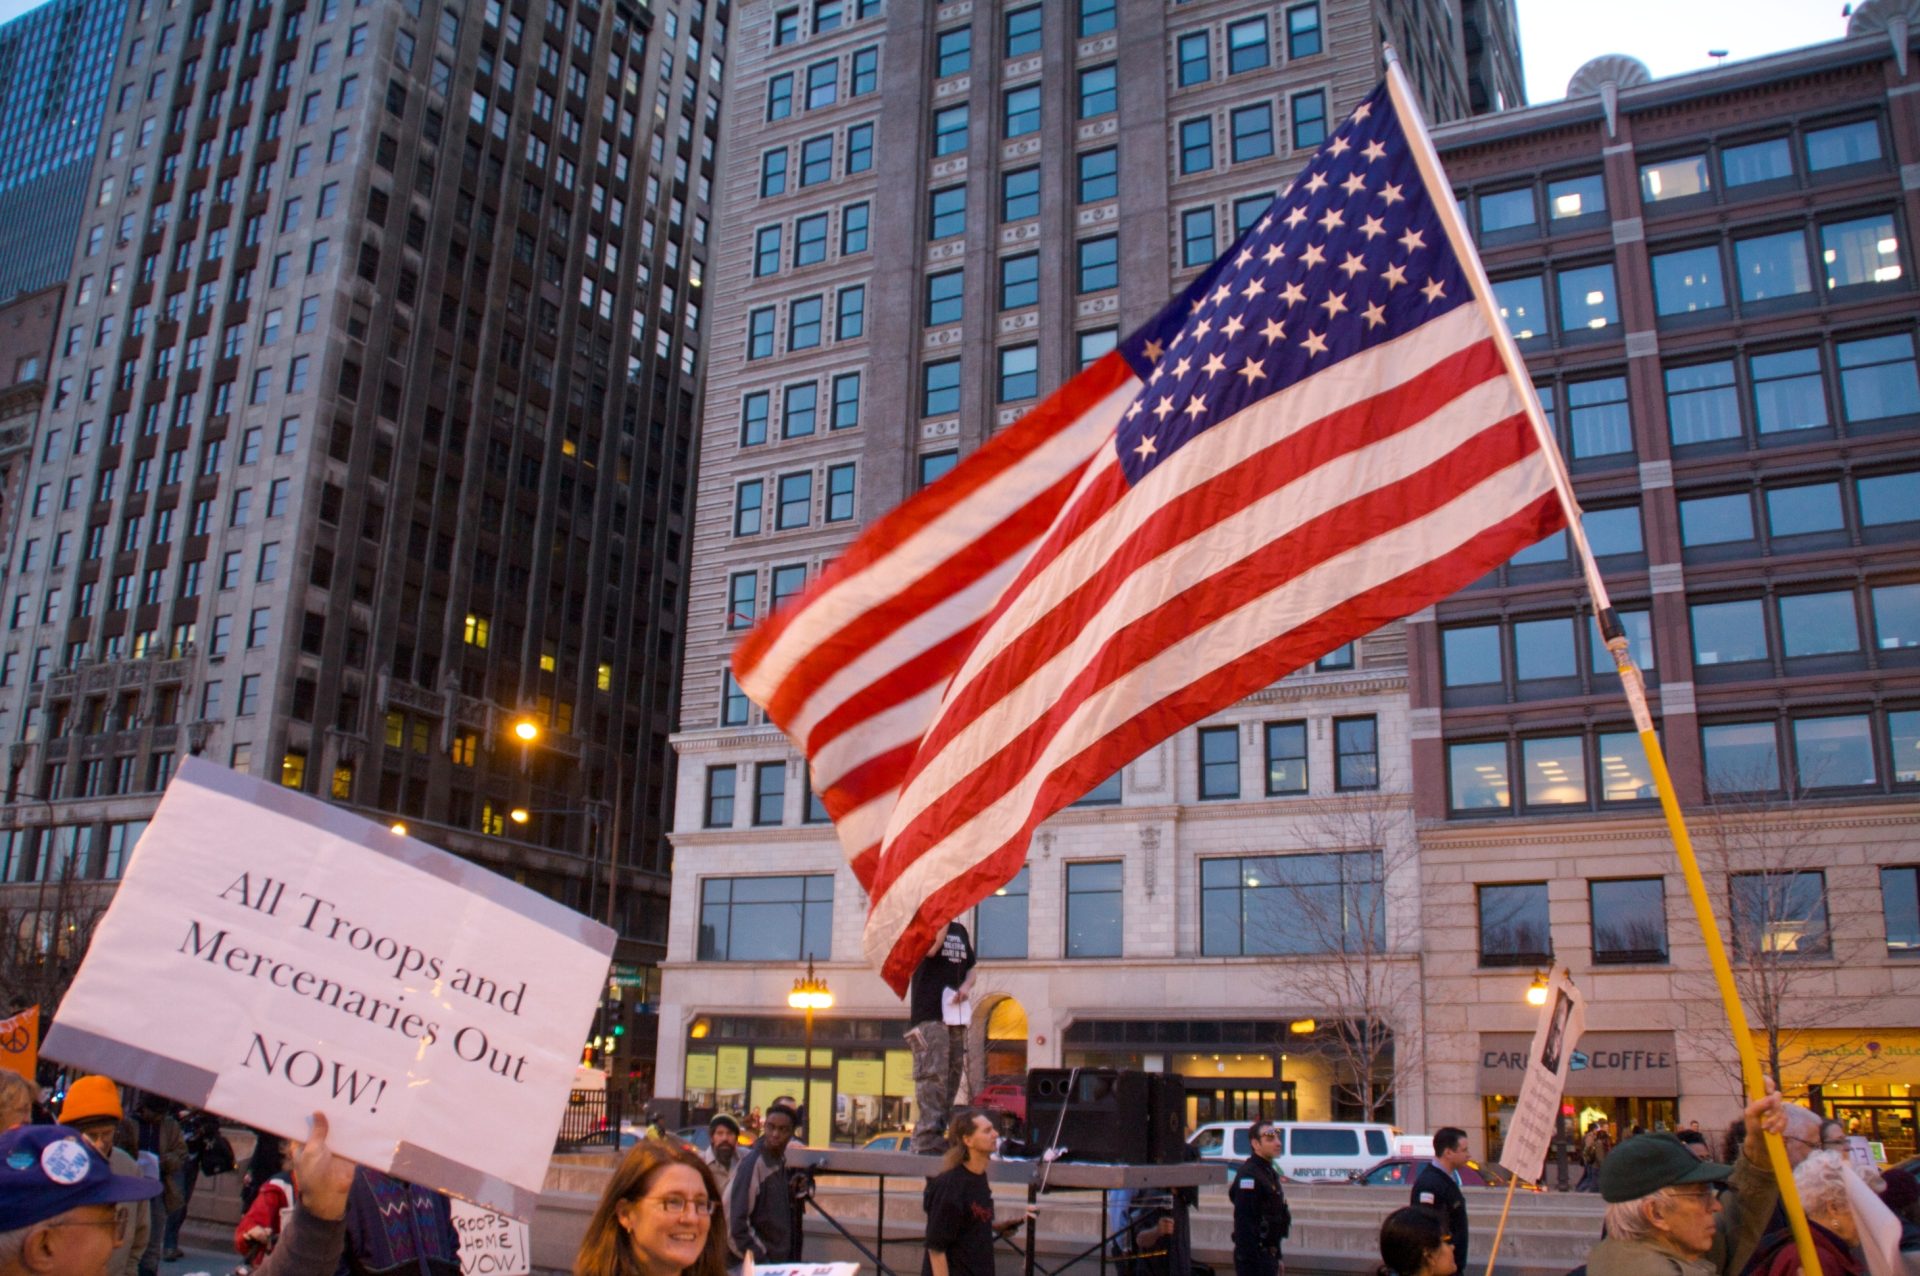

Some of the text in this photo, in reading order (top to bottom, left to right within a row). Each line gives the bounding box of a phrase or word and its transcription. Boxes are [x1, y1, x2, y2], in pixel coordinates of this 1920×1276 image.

[217, 871, 527, 1017] All Troops and
[177, 920, 529, 1084] Mercenaries Out
[240, 1031, 388, 1114] NOW!
[1483, 1050, 1671, 1071] CARI COFFEE
[1293, 1167, 1327, 1177] AIRPORT
[464, 1232, 513, 1252] HOME
